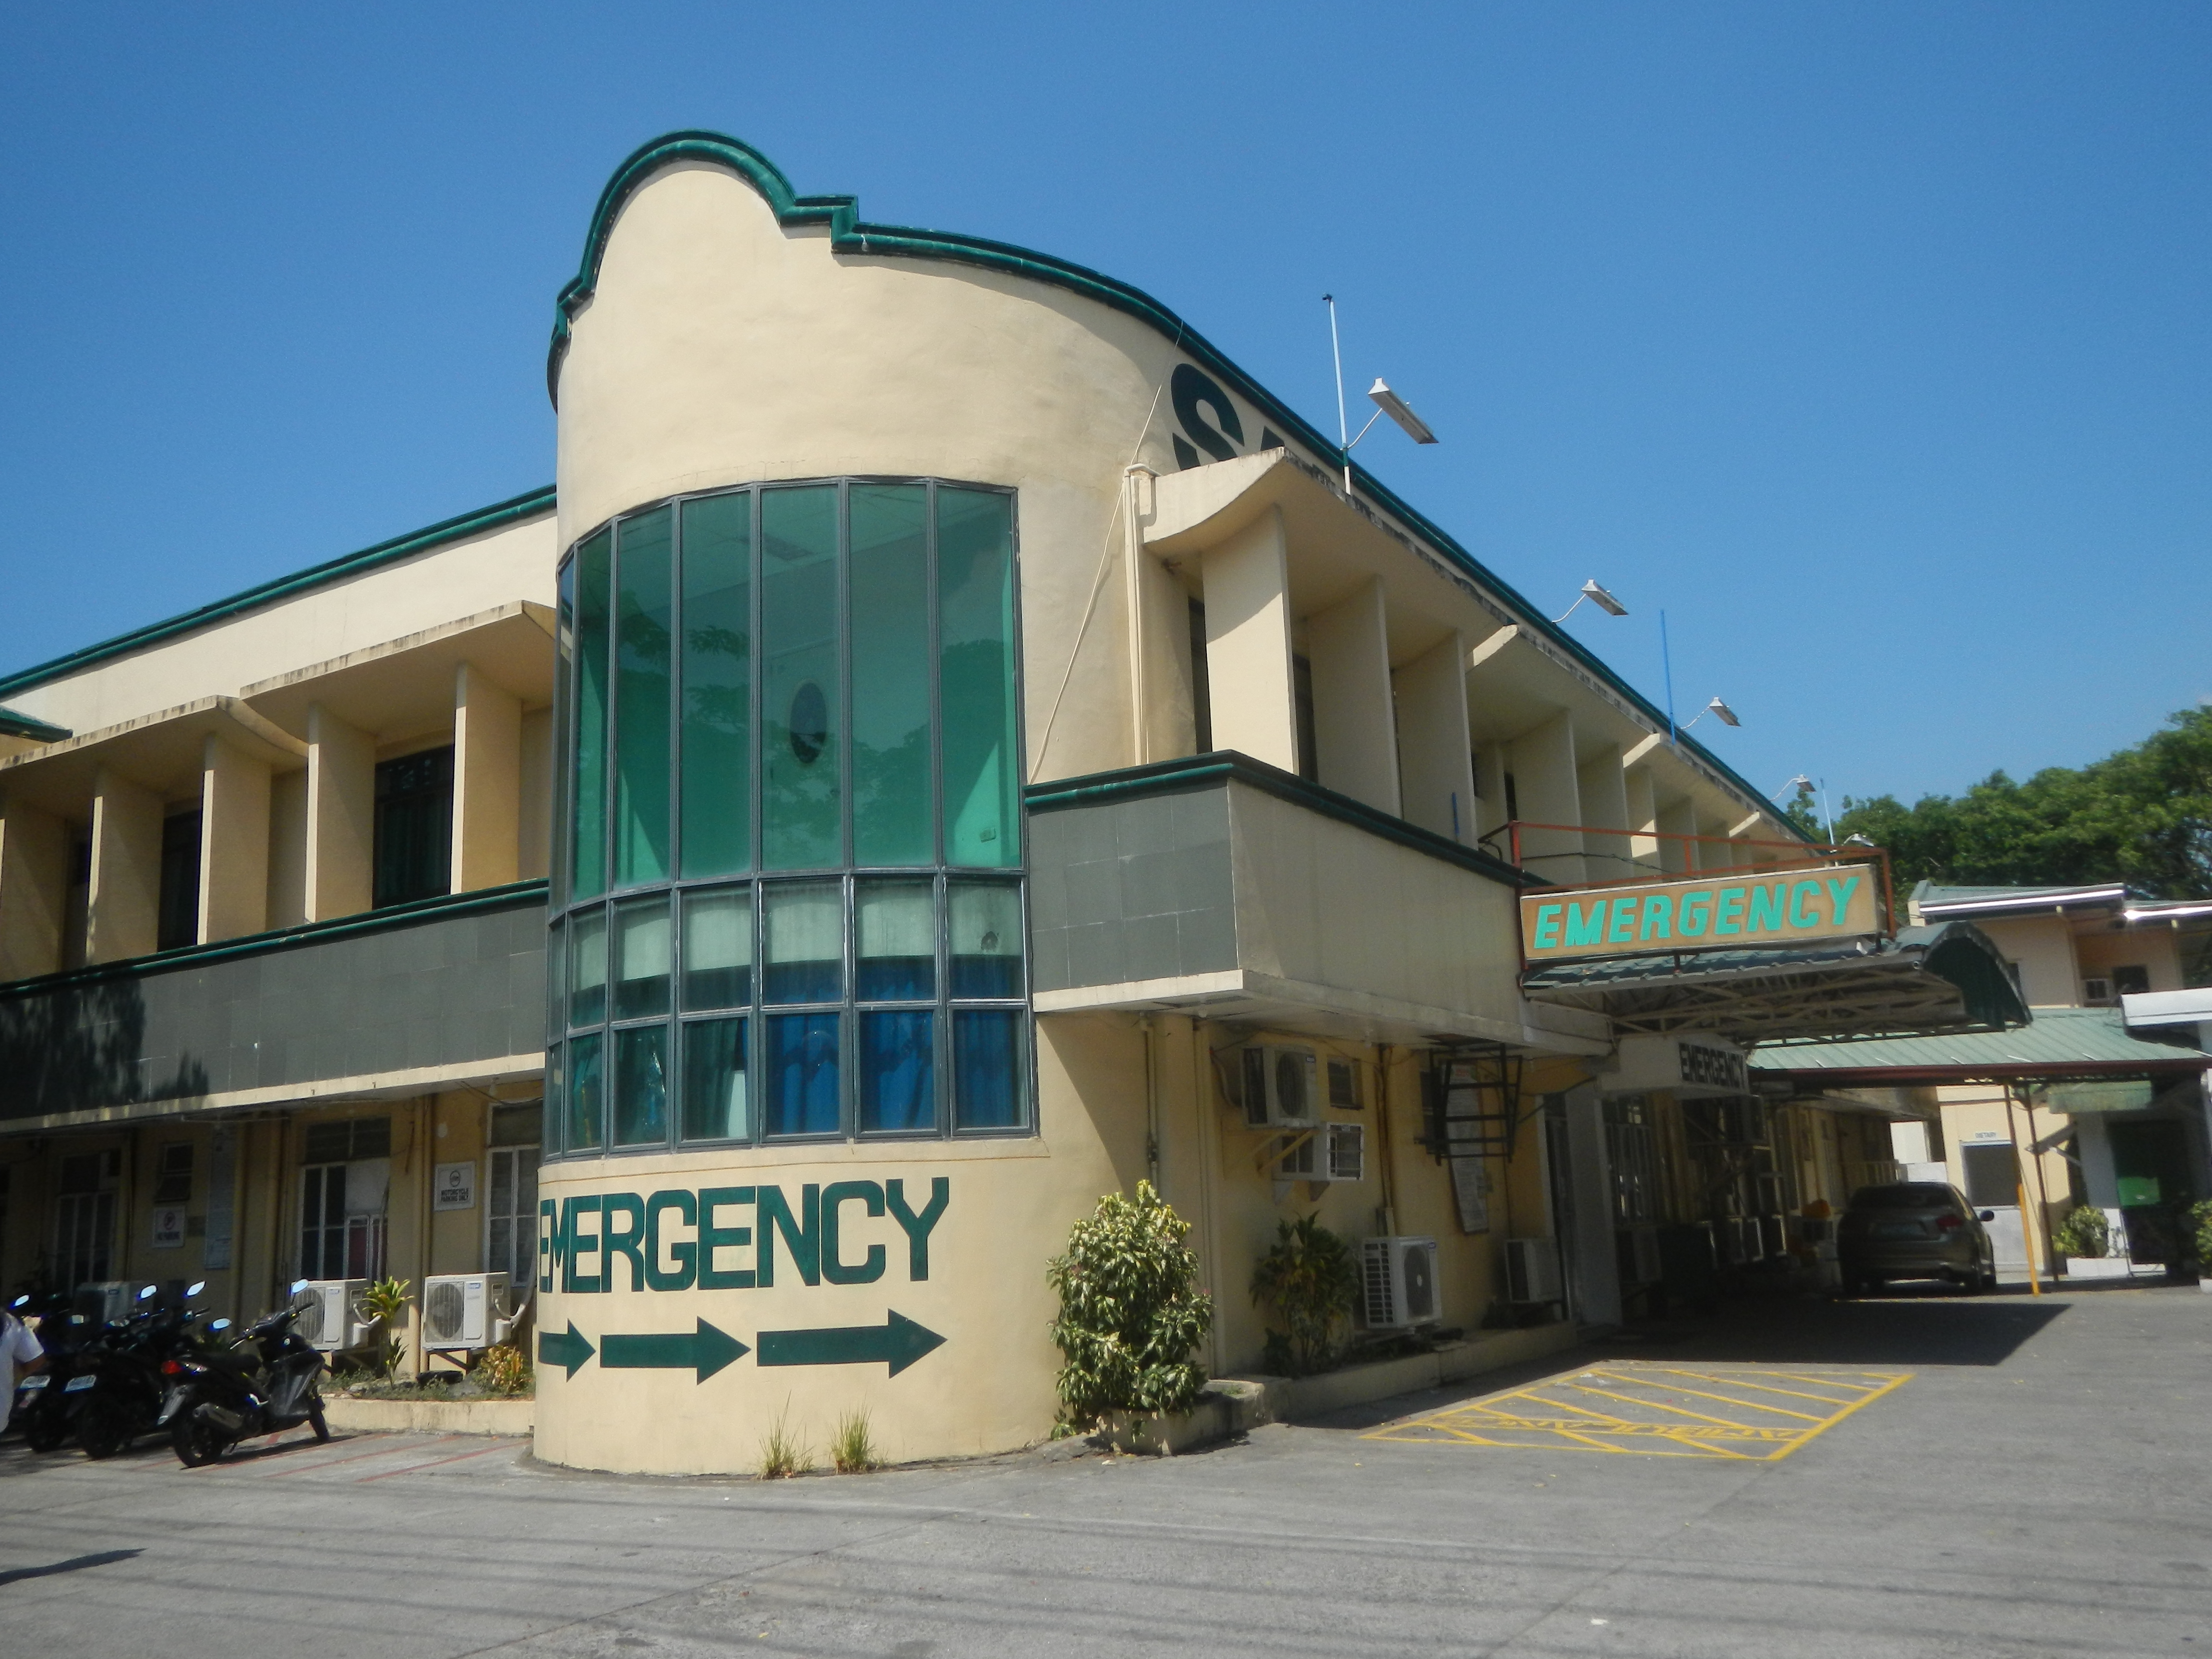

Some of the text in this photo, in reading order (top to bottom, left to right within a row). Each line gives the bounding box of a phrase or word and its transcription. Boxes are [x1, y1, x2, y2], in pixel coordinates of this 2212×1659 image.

[1533, 876, 1861, 949] EMERGENCY
[1679, 1042, 1746, 1090] EMERGENCY
[441, 1187, 469, 1196] MOTORCYCLE
[540, 1177, 950, 1293] EMERGENCY
